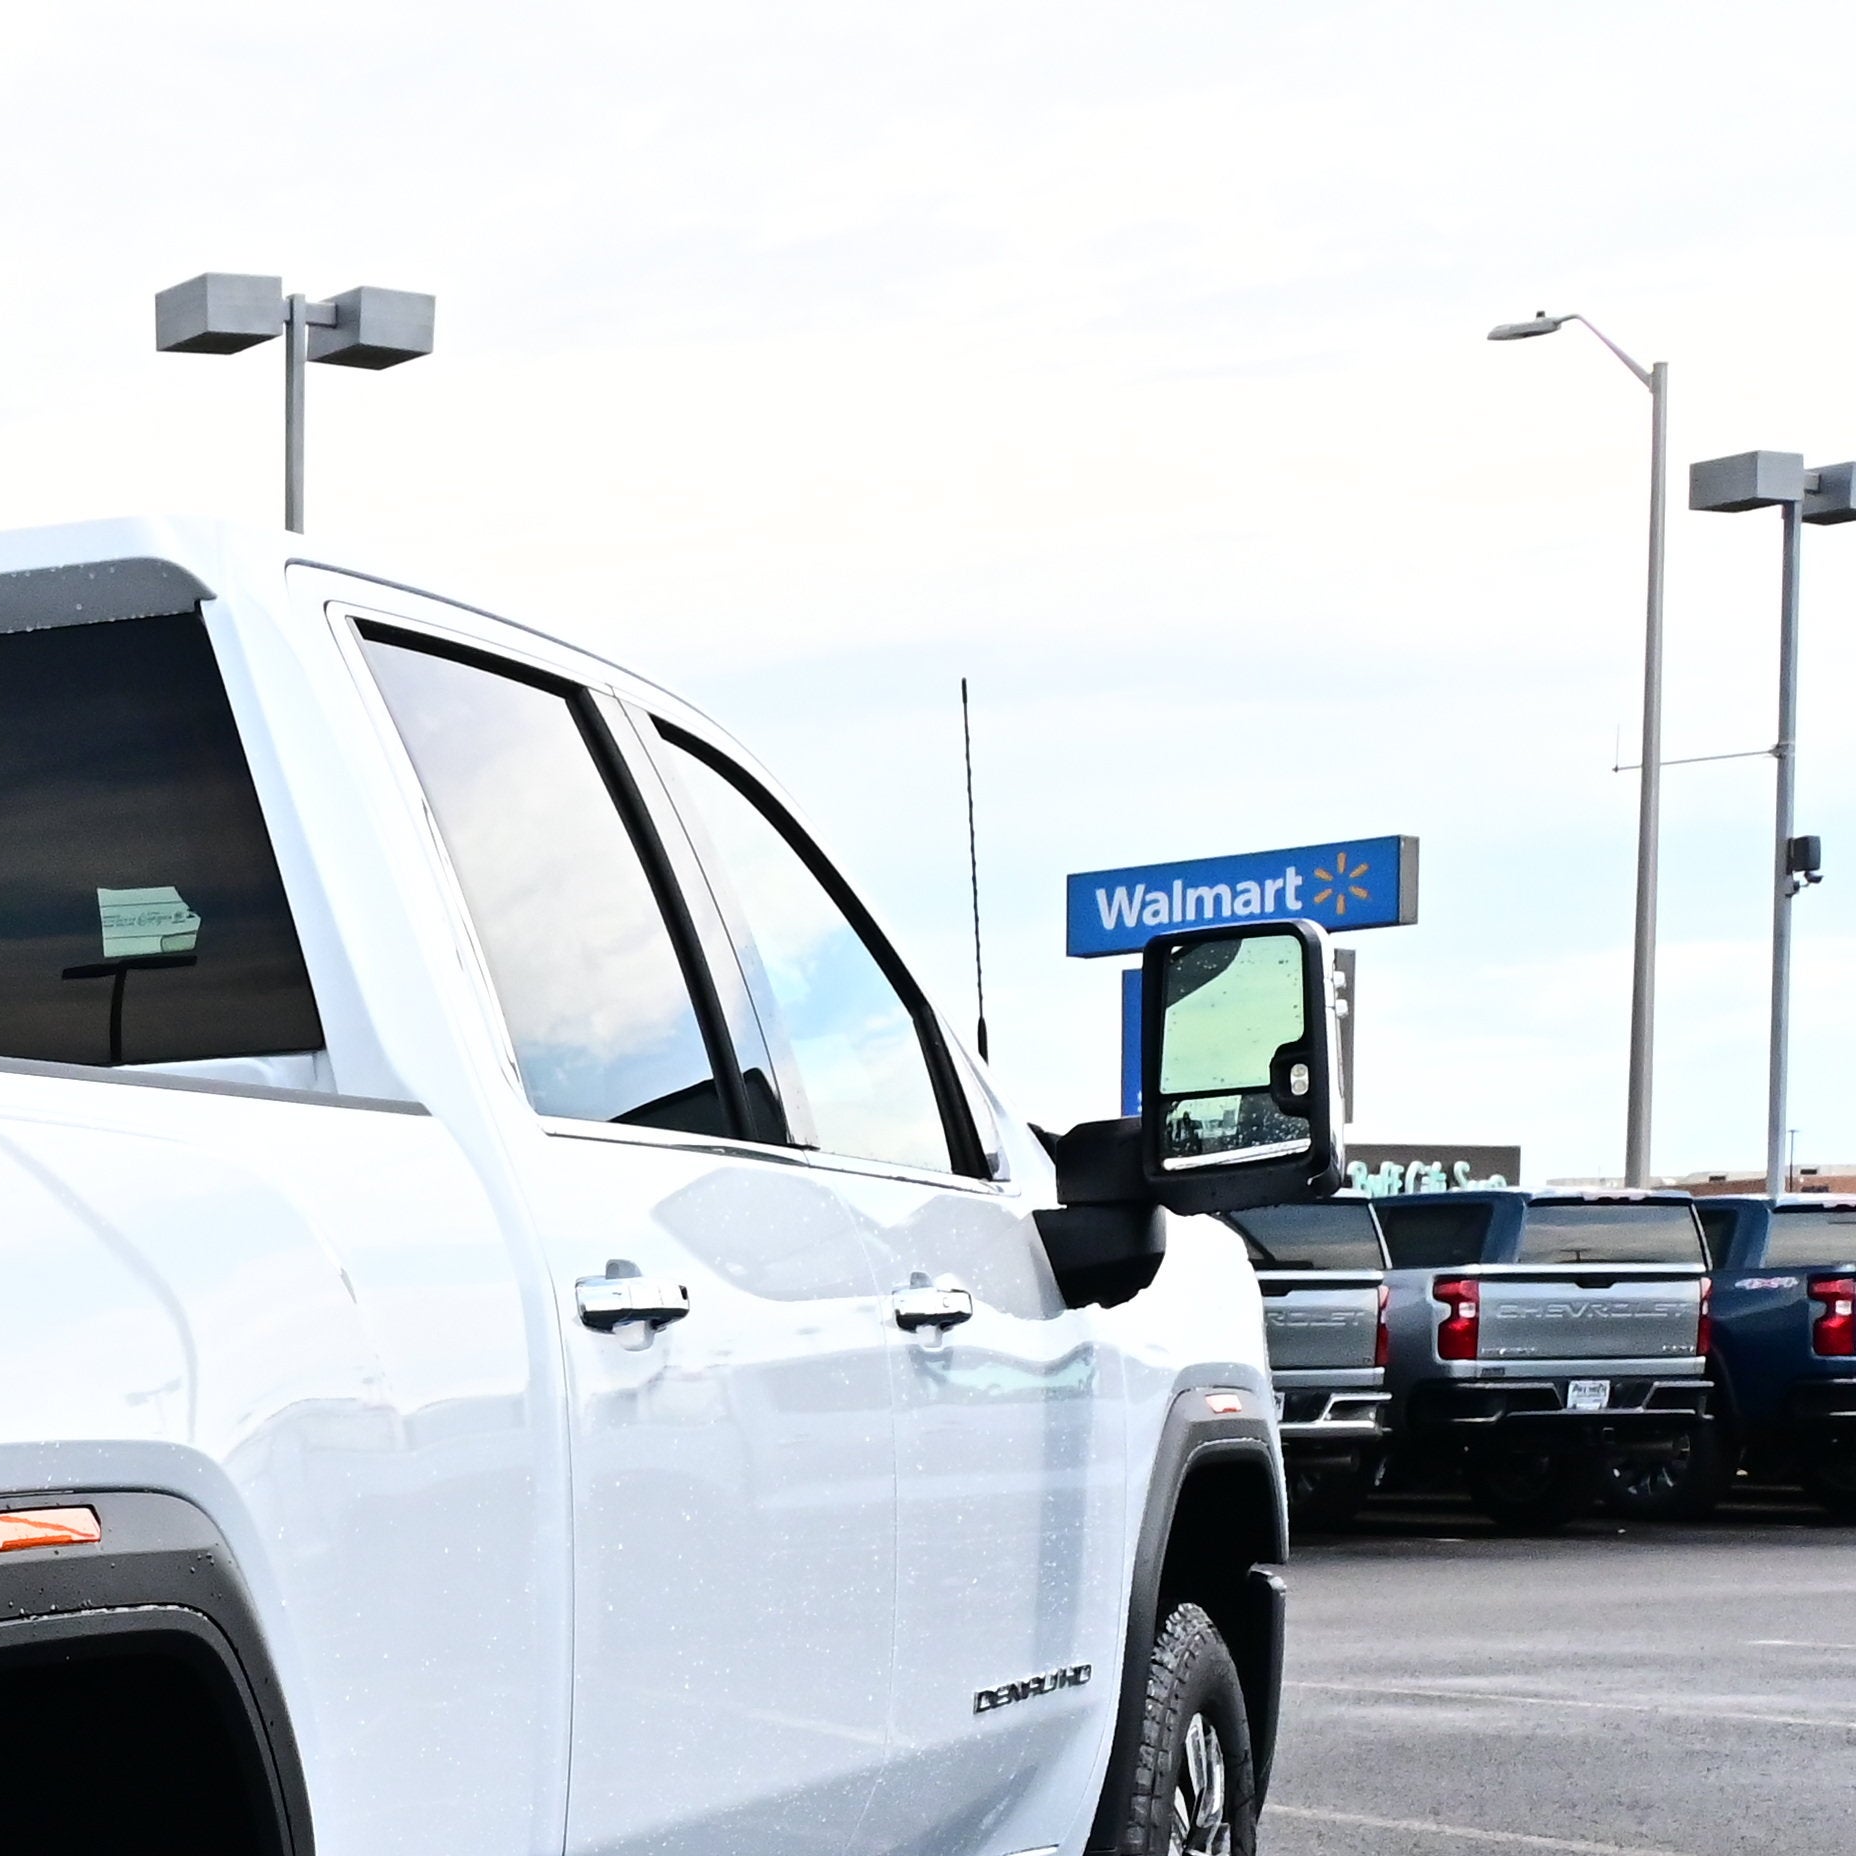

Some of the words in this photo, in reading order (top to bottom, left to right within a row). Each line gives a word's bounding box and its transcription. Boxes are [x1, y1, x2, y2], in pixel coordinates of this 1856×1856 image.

[1096, 866, 1303, 930] Walmart
[1266, 1311, 1365, 1327] ROLET
[1496, 1302, 1690, 1320] CHEVROLET
